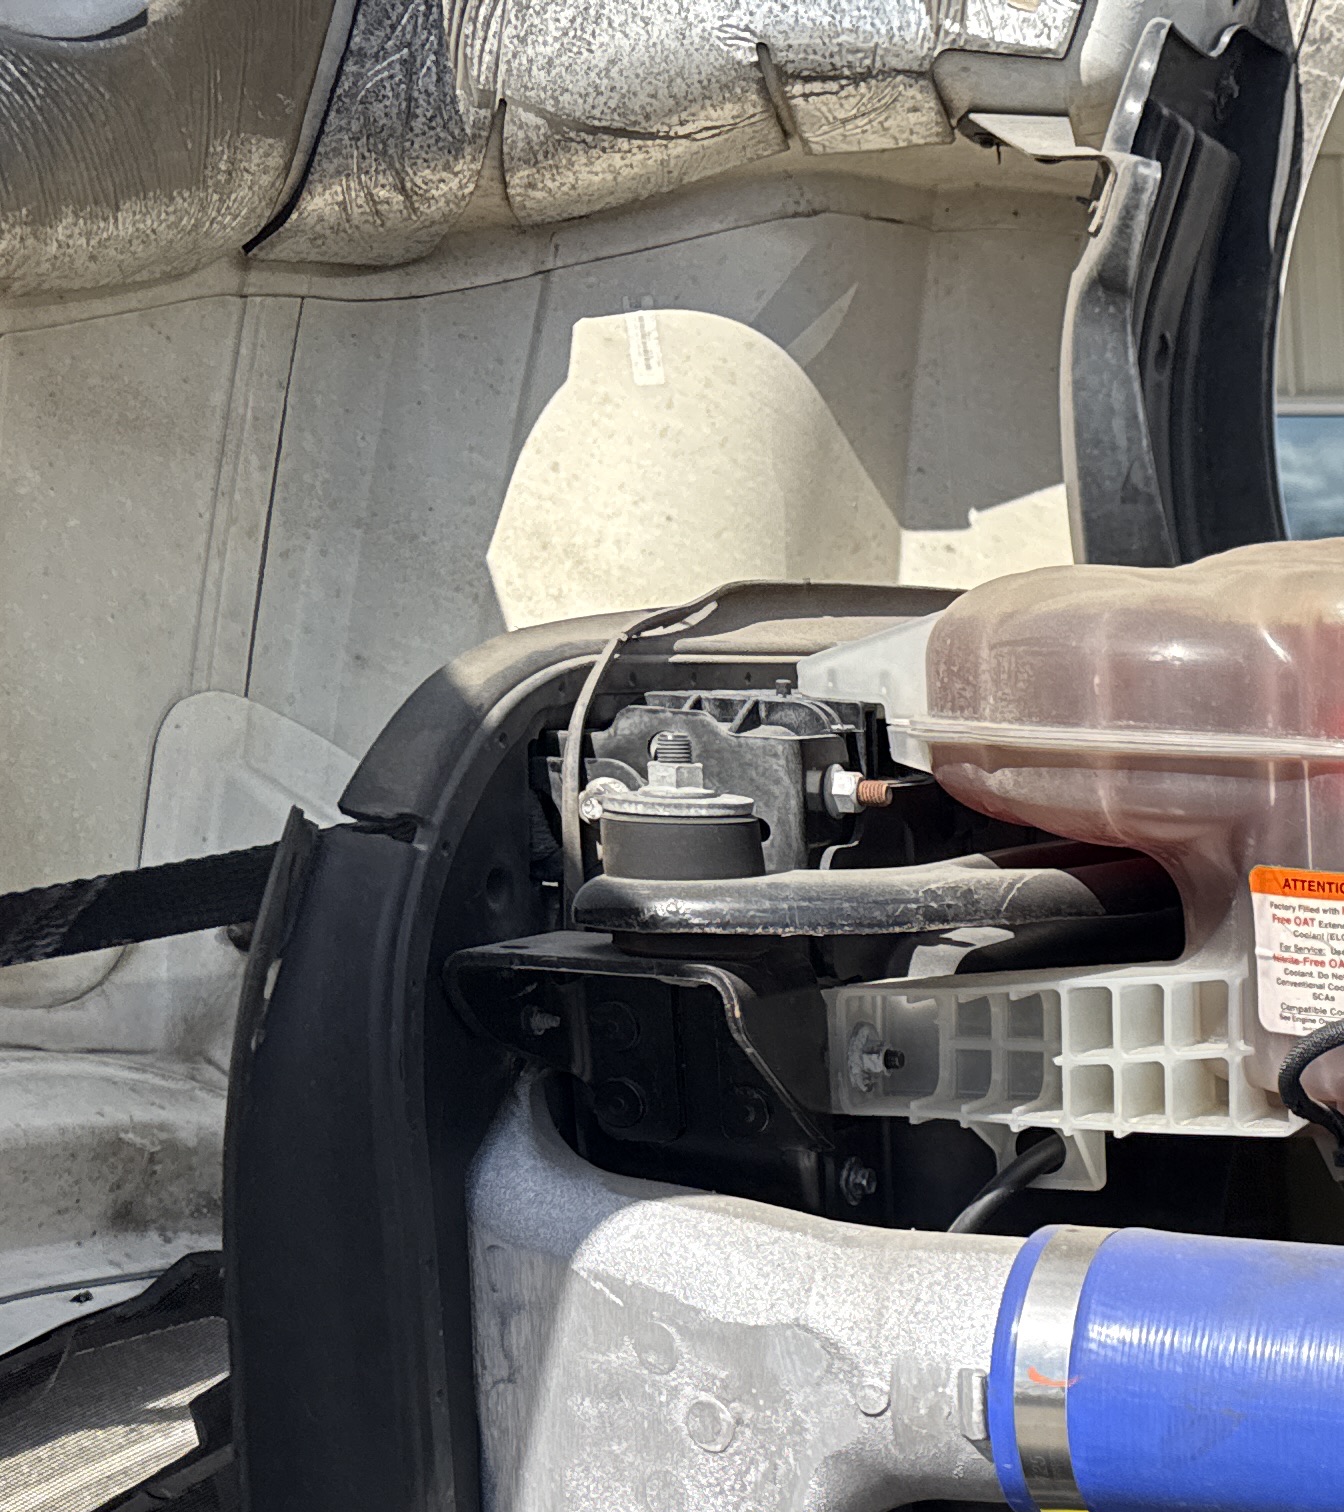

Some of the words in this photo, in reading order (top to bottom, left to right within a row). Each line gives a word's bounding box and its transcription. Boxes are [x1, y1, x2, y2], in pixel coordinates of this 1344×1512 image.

[1270, 902, 1296, 913] Factory
[1298, 904, 1320, 914] Filled
[1322, 906, 1339, 915] with
[1272, 914, 1291, 924] Free
[1294, 916, 1316, 926] OAT
[1293, 931, 1325, 940] Coolant
[1280, 943, 1292, 952] For
[1317, 971, 1329, 979] Do
[1276, 978, 1325, 990] Conventional
[1312, 993, 1335, 1001] SCAs
[1281, 1002, 1327, 1015] Compatible
